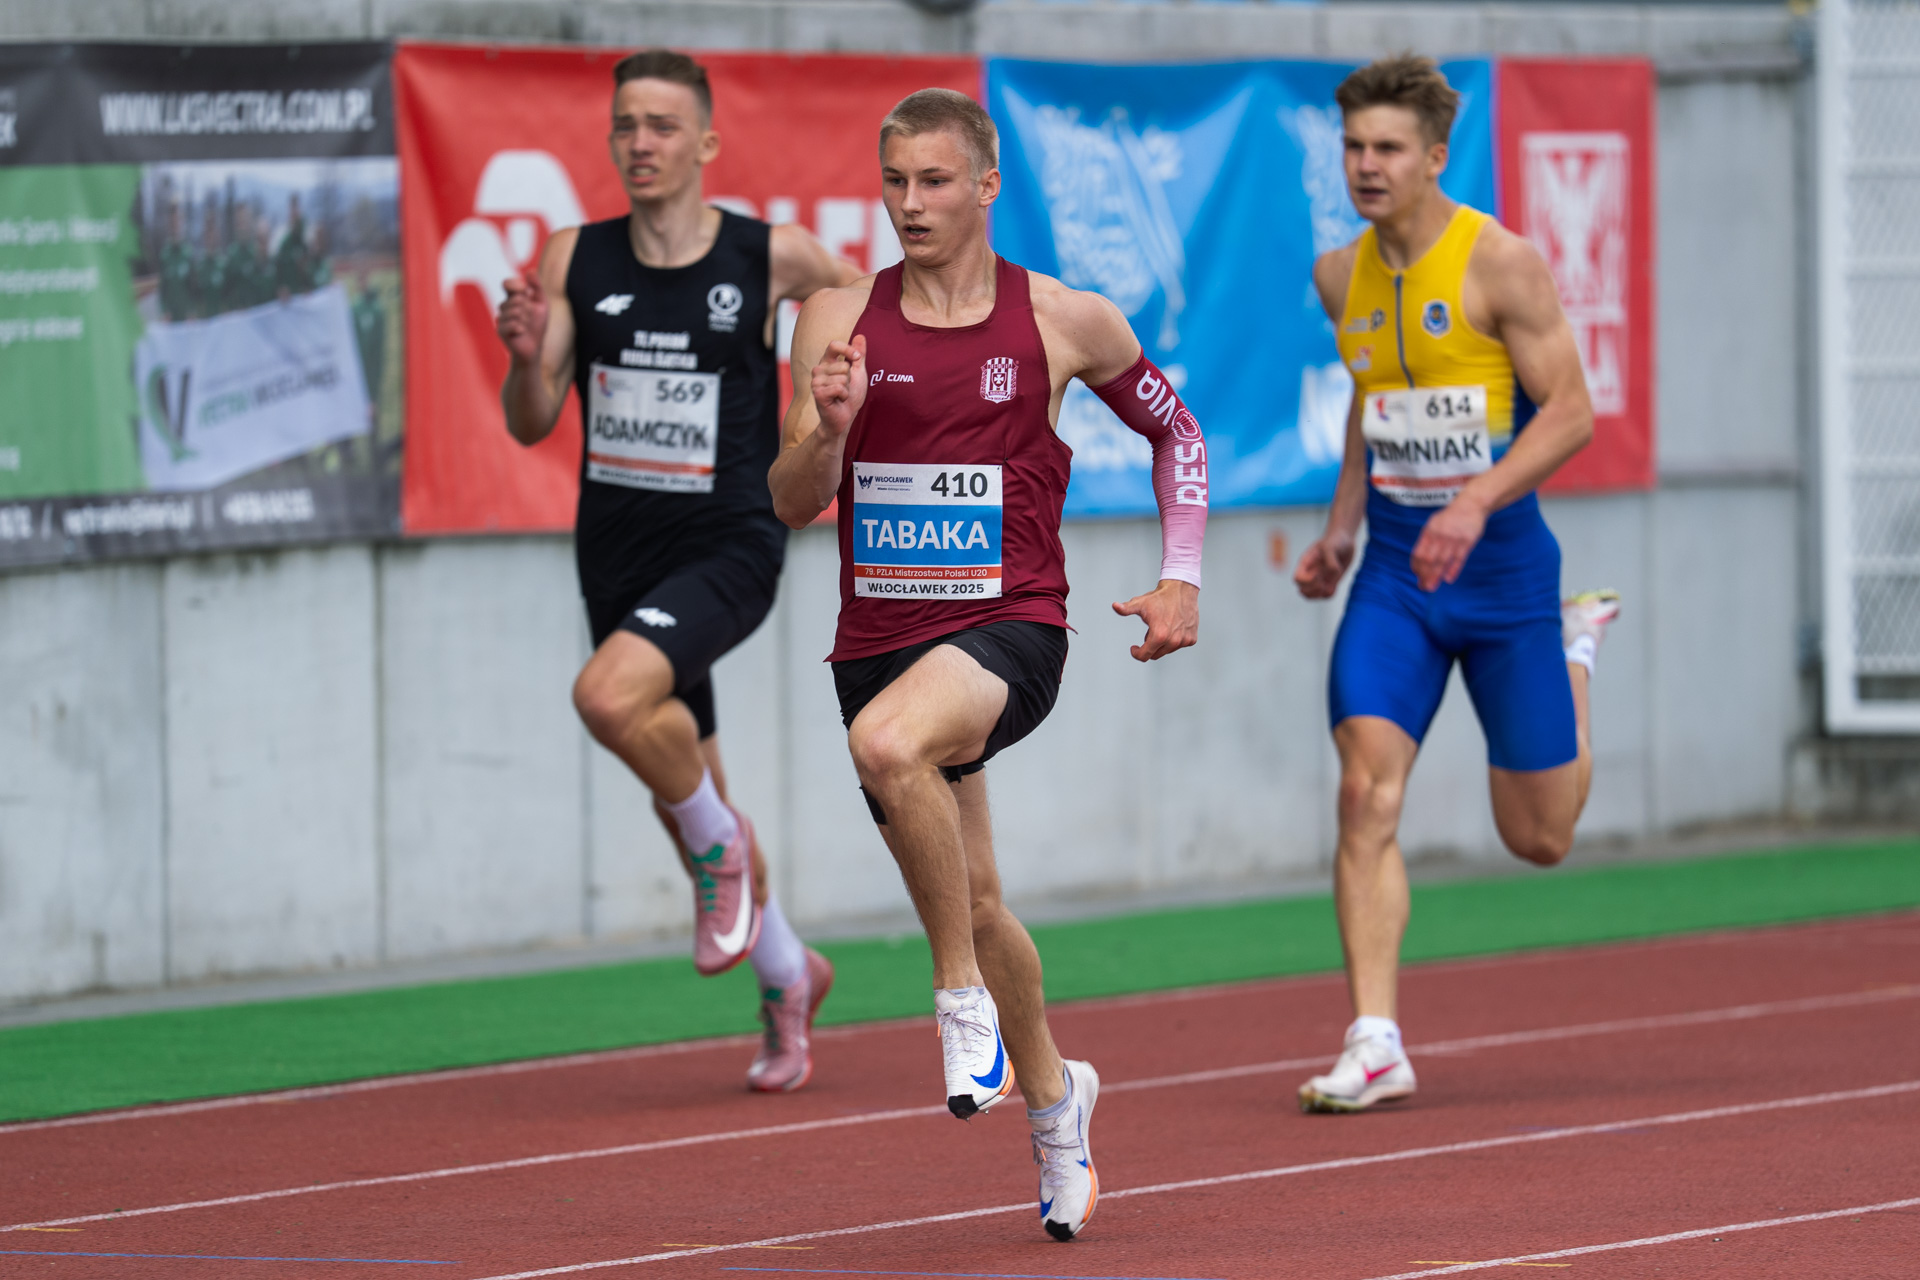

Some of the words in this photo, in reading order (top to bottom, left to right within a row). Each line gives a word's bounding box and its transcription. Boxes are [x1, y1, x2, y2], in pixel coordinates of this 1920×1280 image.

[886, 374, 914, 383] CUNA
[656, 379, 706, 403] 569
[1426, 396, 1472, 417] 614
[931, 472, 988, 498] 410
[862, 519, 989, 550] TABAKA
[865, 568, 875, 576] 79.
[895, 569, 943, 577] Mistrzostwa
[945, 569, 969, 578] Polski
[971, 569, 988, 577] U20
[868, 583, 948, 594] WŁOCŁAWEK
[951, 584, 985, 594] 2025
